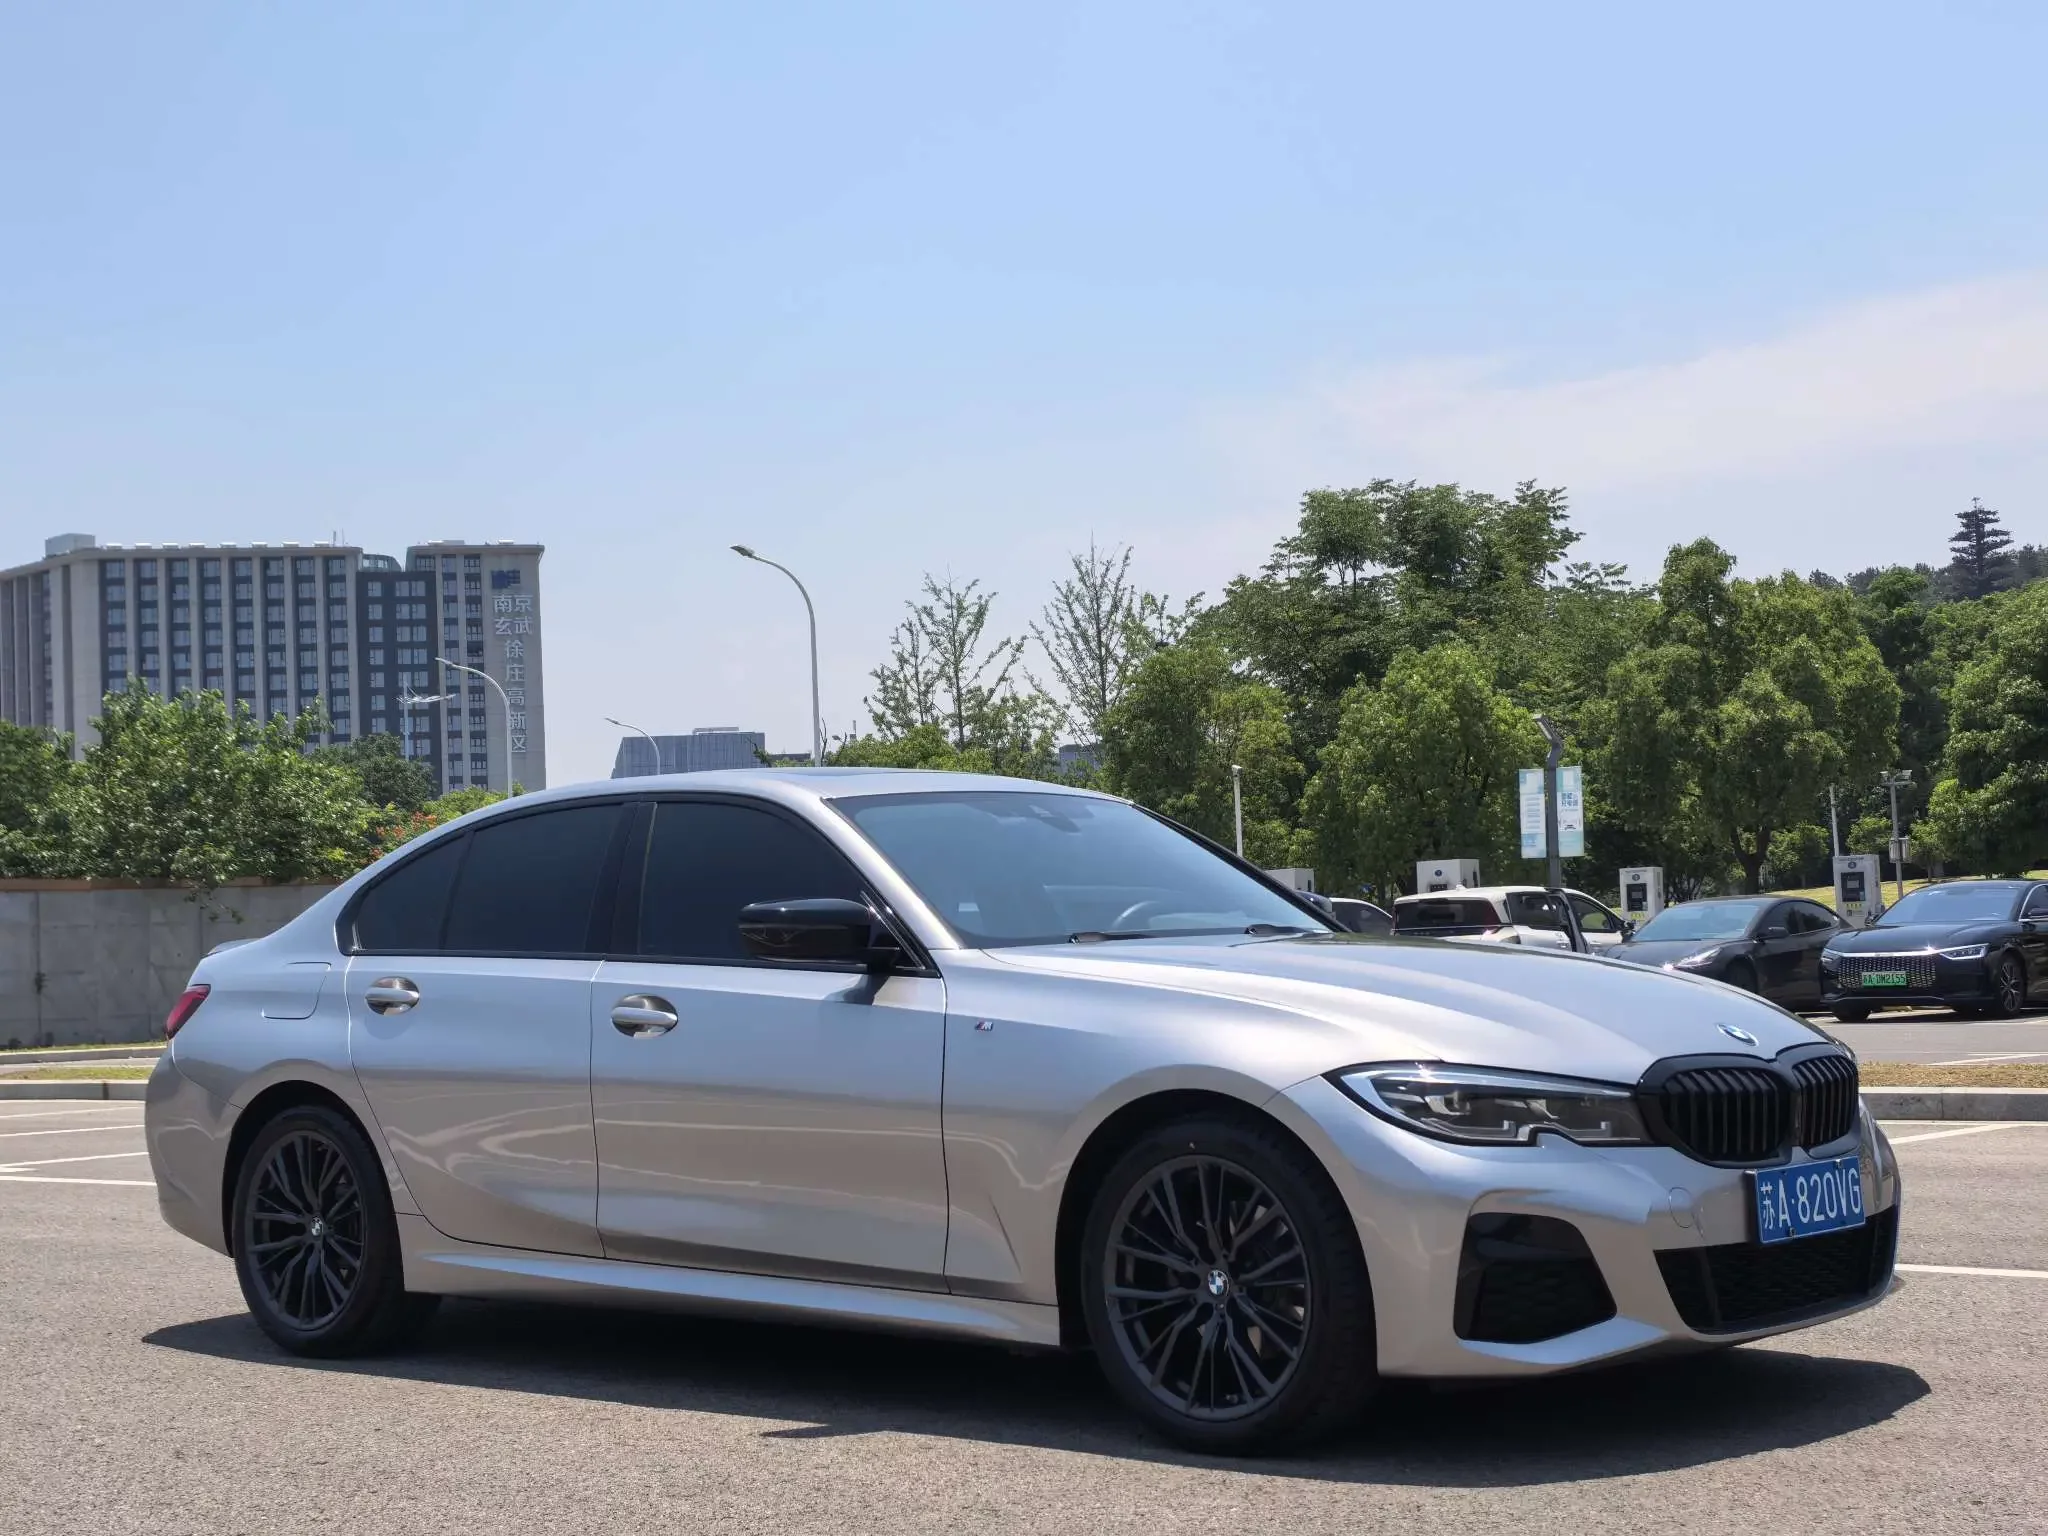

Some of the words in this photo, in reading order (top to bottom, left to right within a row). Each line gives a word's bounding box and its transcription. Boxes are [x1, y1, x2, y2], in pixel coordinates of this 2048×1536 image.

[492, 594, 533, 613] 南京
[494, 616, 533, 635] 玄武
[505, 640, 527, 753] 徐庄高新区
[1760, 1168, 1861, 1230] 苏A·820VG
